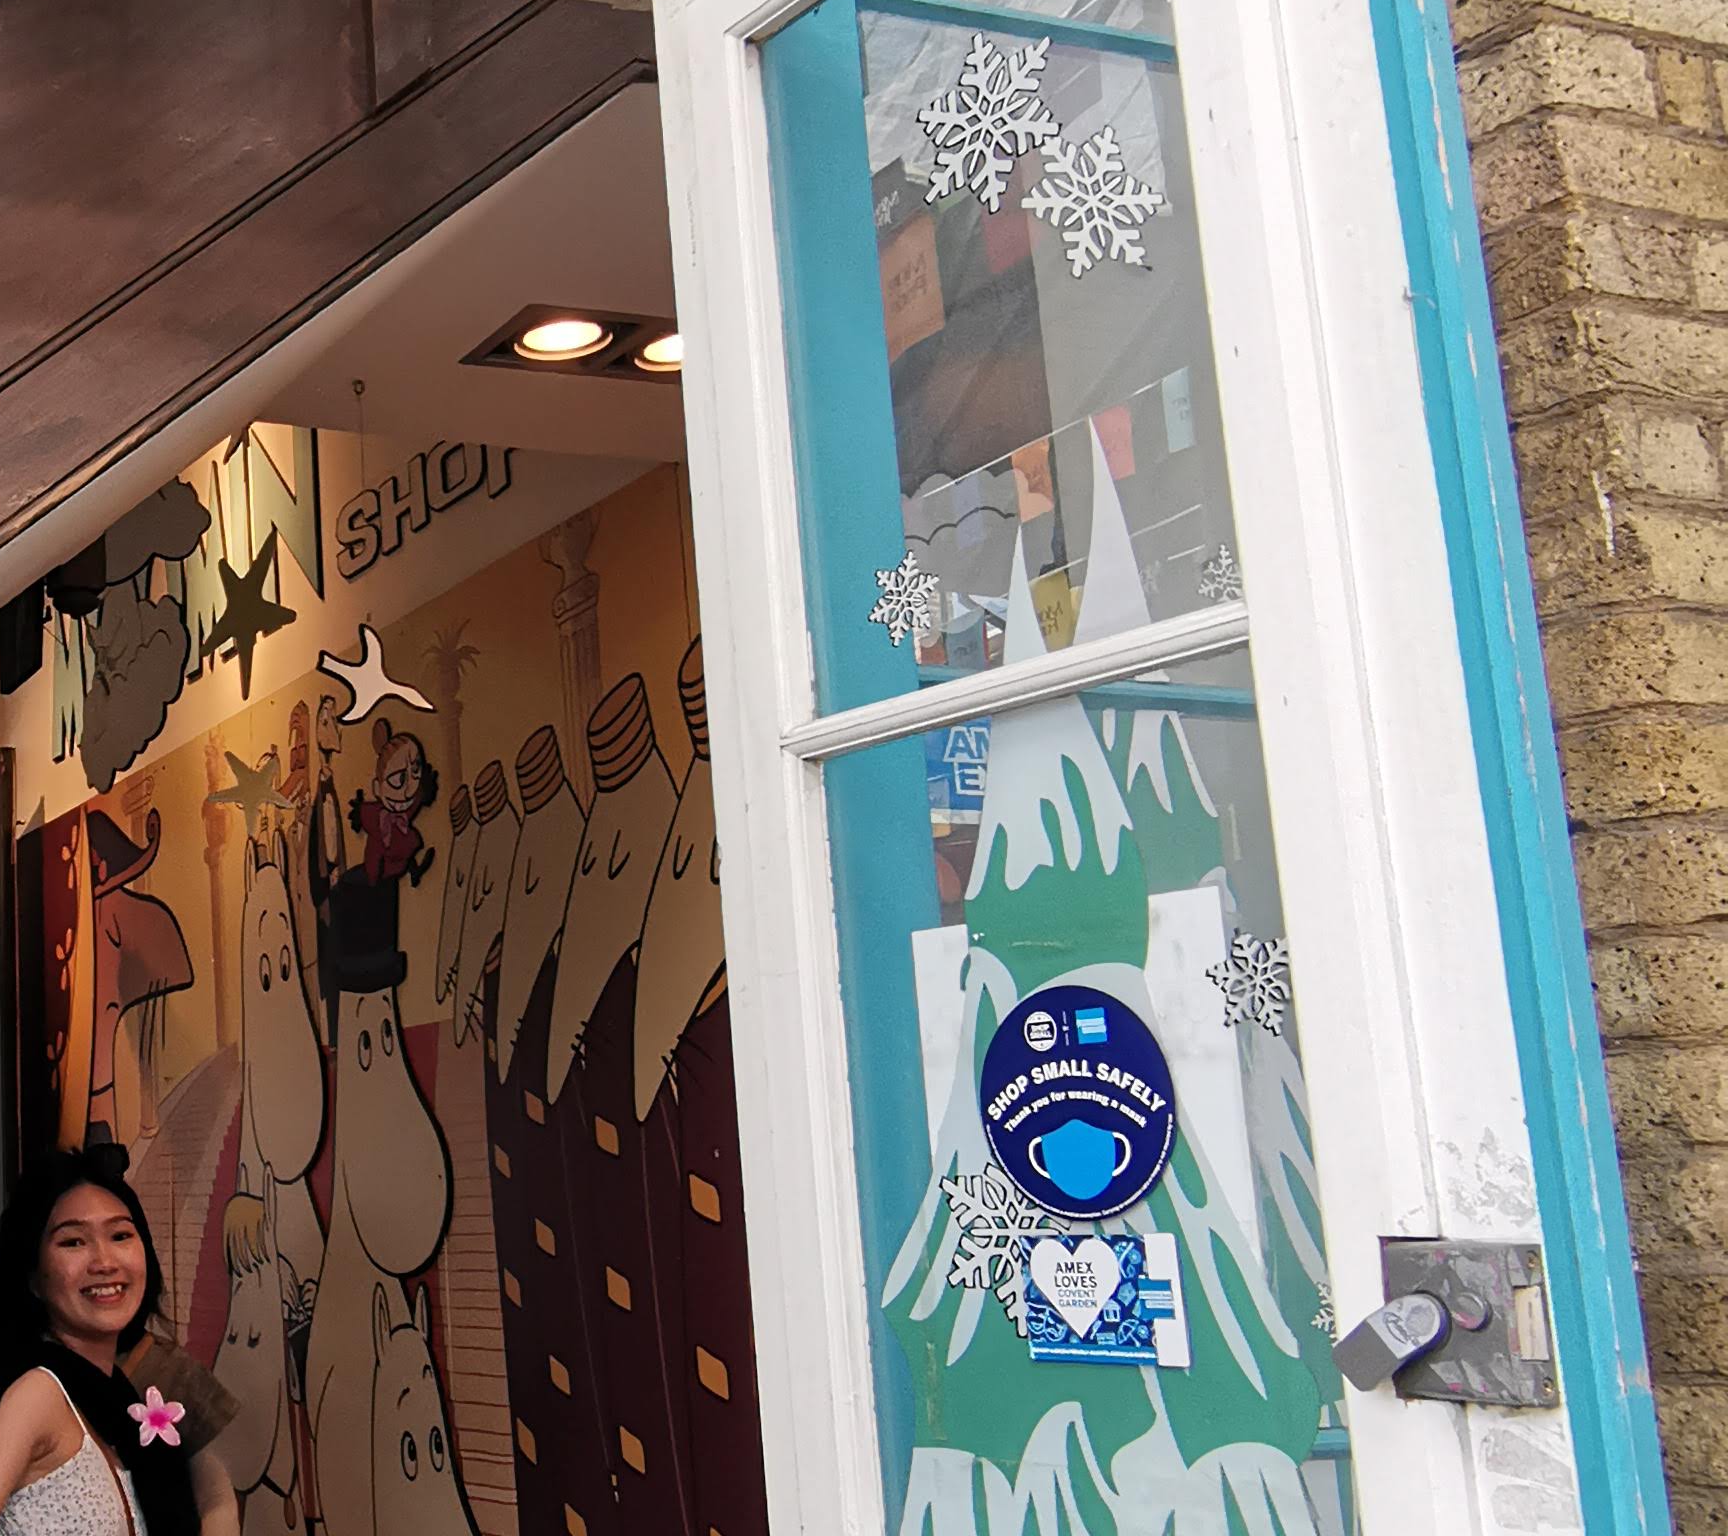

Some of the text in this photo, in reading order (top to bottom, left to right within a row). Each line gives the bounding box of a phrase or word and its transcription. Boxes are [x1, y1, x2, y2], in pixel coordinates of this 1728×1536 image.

[986, 1059, 1167, 1122] SHOP SMALL SAFELY
[1003, 1104, 1033, 1133] Thank
[1030, 1096, 1051, 1114] you
[1049, 1090, 1067, 1103] for
[1067, 1090, 1110, 1108] wearing
[1055, 1261, 1094, 1274] AMEX
[1054, 1275, 1098, 1289] LOVES
[1057, 1289, 1096, 1298] COVENT
[1058, 1299, 1098, 1308] GARDEN
